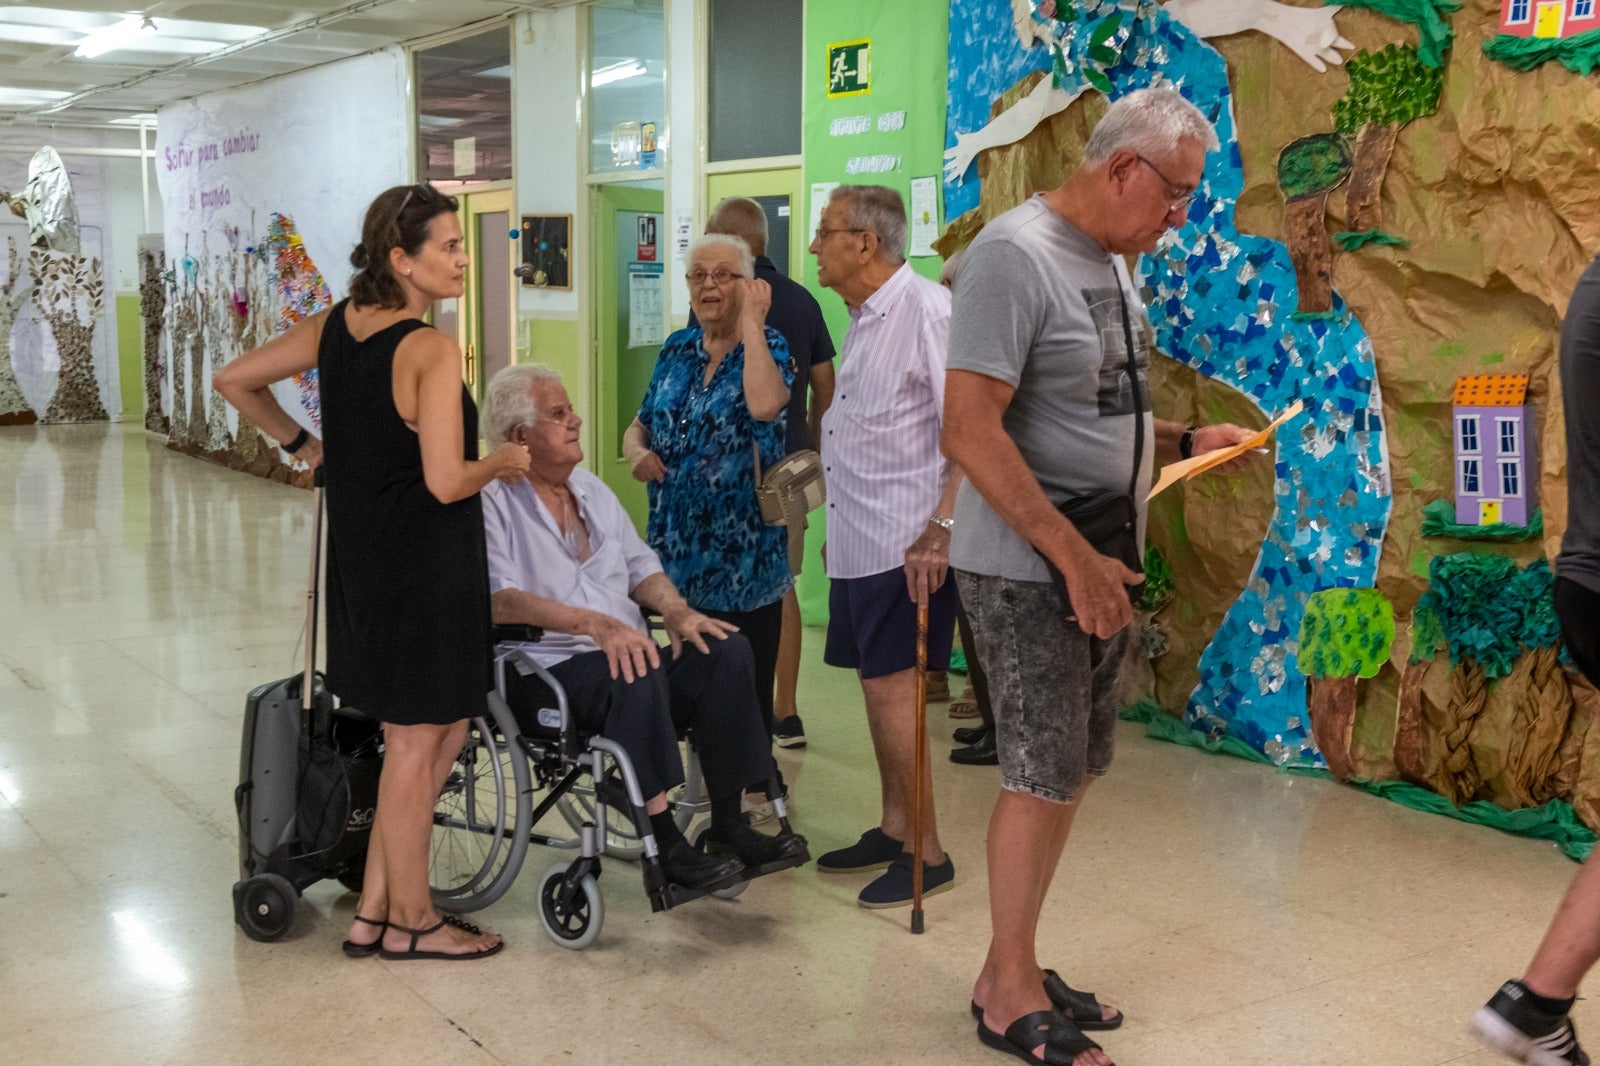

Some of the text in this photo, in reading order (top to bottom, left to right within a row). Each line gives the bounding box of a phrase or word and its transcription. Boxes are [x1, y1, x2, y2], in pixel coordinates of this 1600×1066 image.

[198, 143, 218, 170] para
[223, 126, 260, 156] cambiar
[201, 184, 230, 209] mundo
